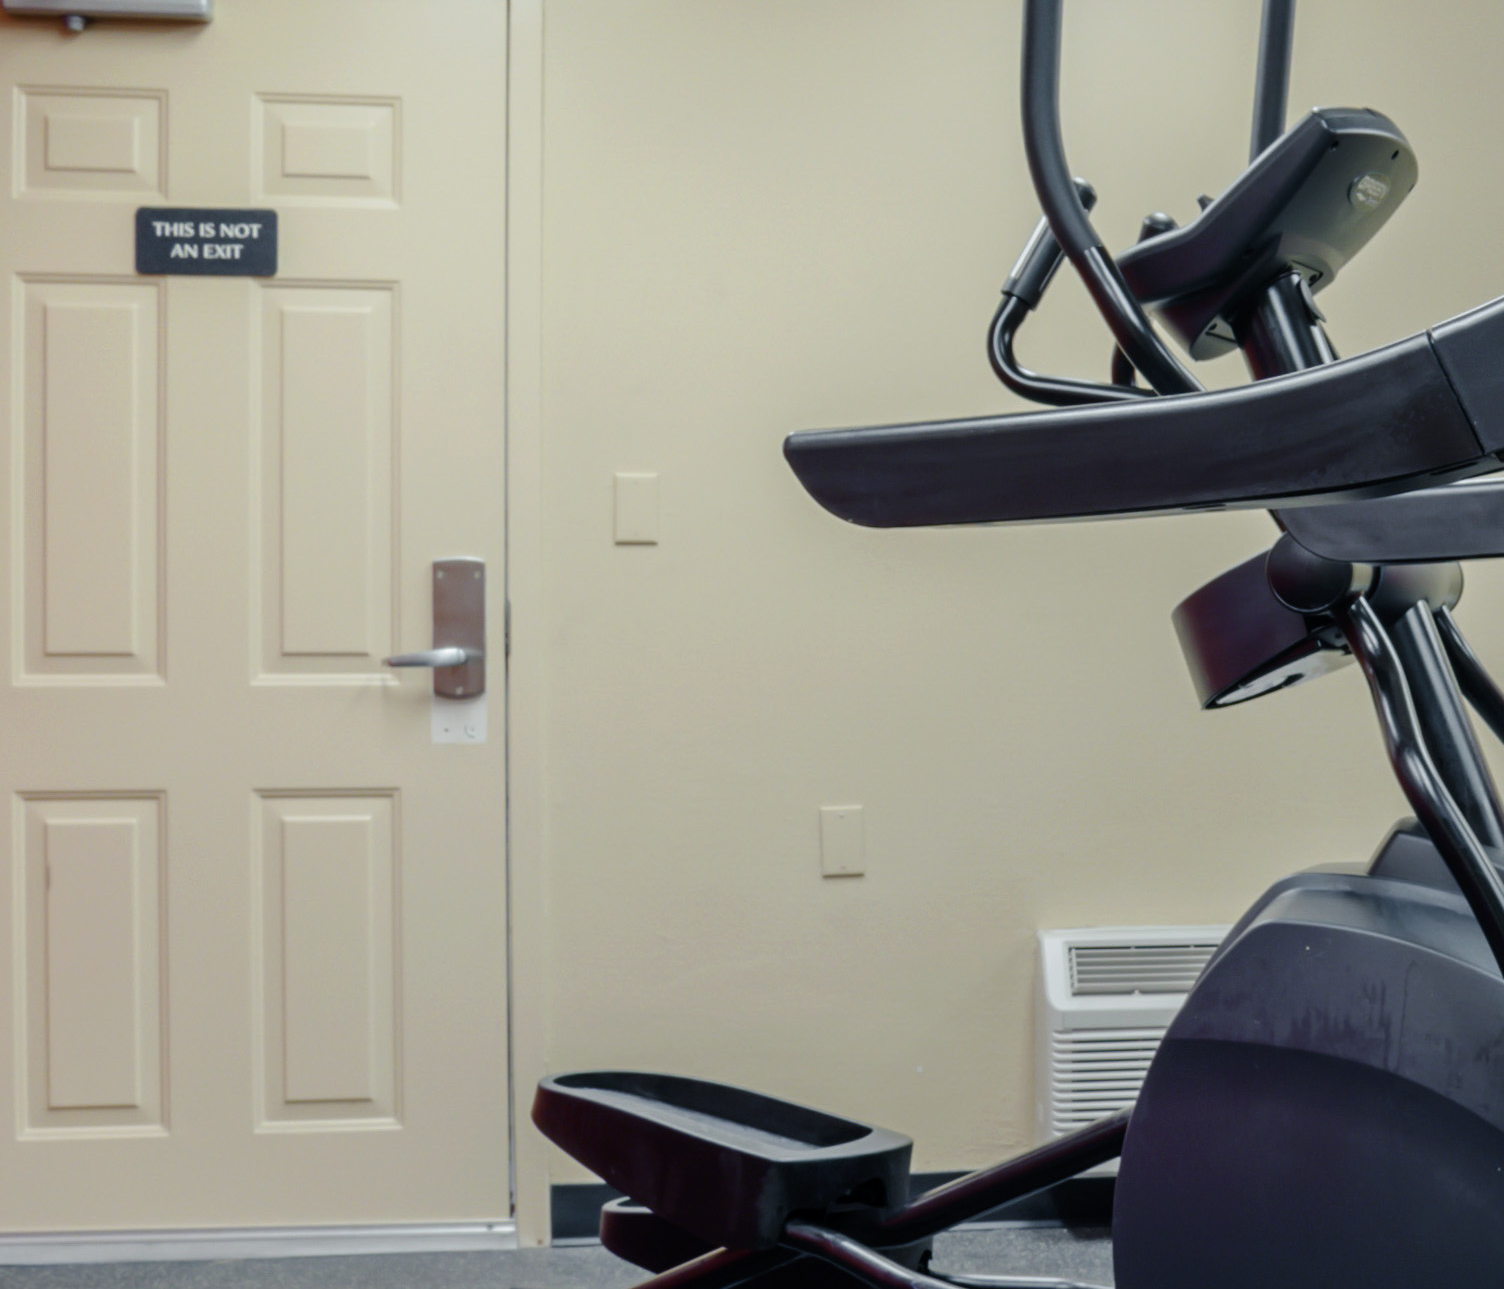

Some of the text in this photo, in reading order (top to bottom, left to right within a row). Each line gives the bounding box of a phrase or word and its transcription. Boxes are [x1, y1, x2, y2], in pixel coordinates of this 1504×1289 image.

[152, 221, 262, 239] THIS IS NOT
[170, 243, 244, 260] AN EXIT
